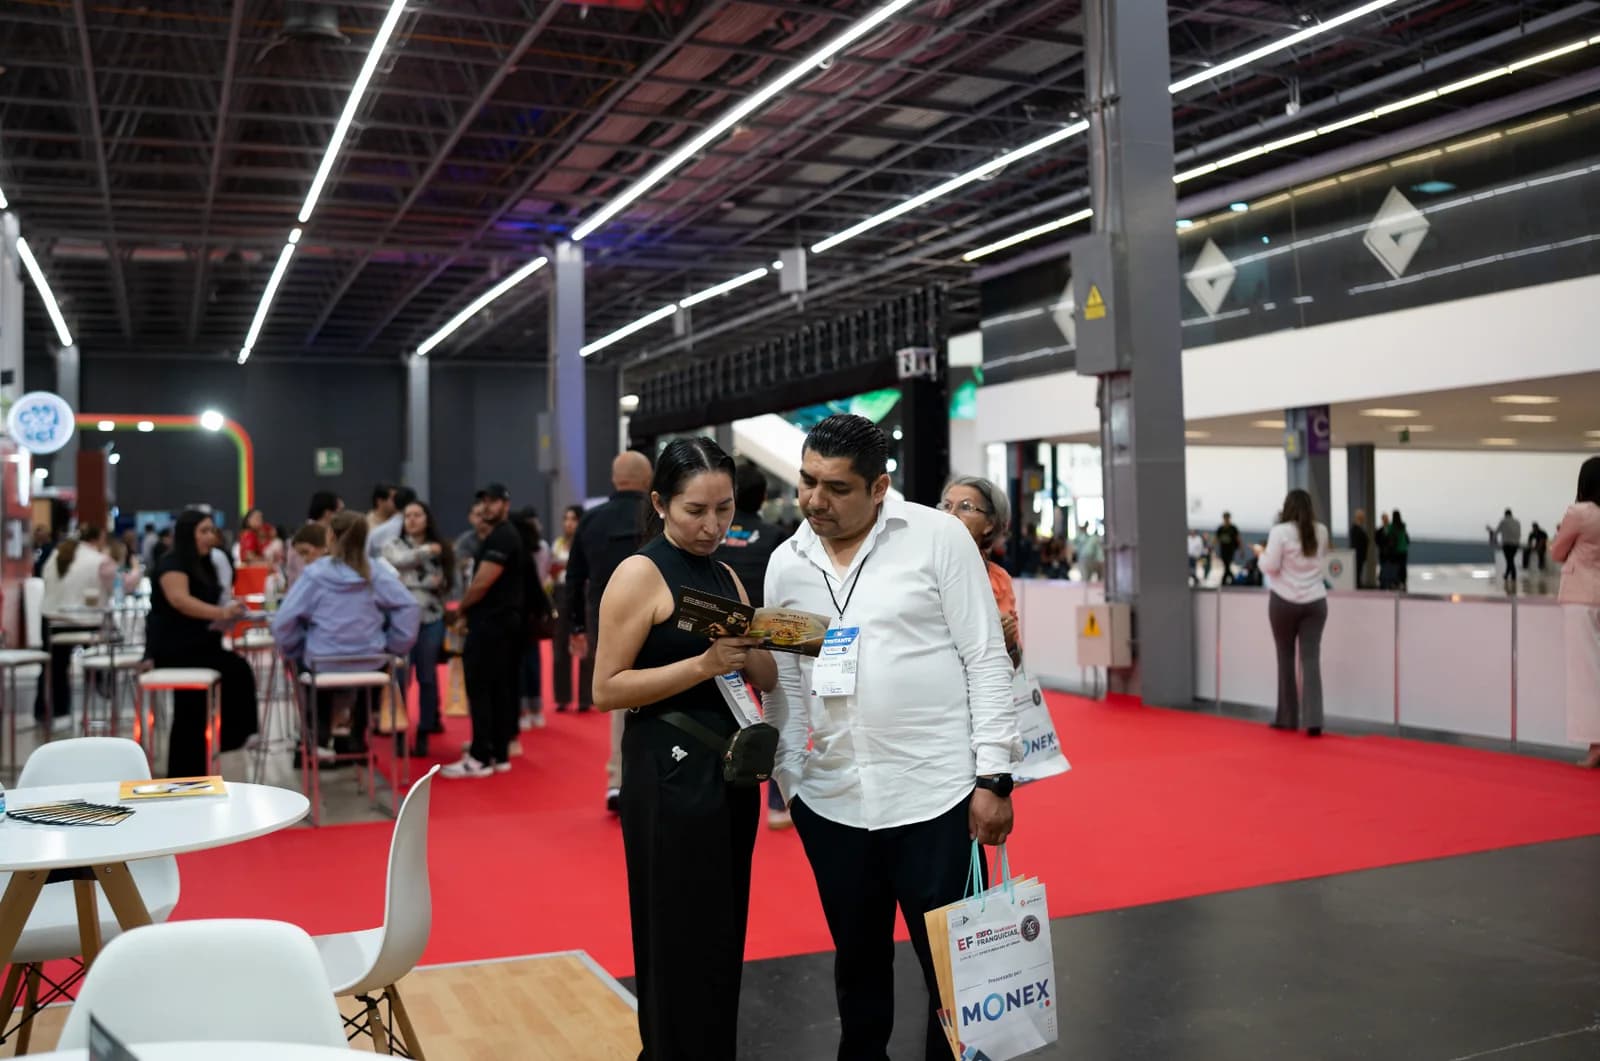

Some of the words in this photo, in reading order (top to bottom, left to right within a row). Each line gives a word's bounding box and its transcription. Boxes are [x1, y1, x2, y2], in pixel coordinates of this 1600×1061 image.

[1023, 731, 1055, 757] ONEX
[957, 936, 973, 951] EF
[962, 978, 1050, 1027] MONEX
